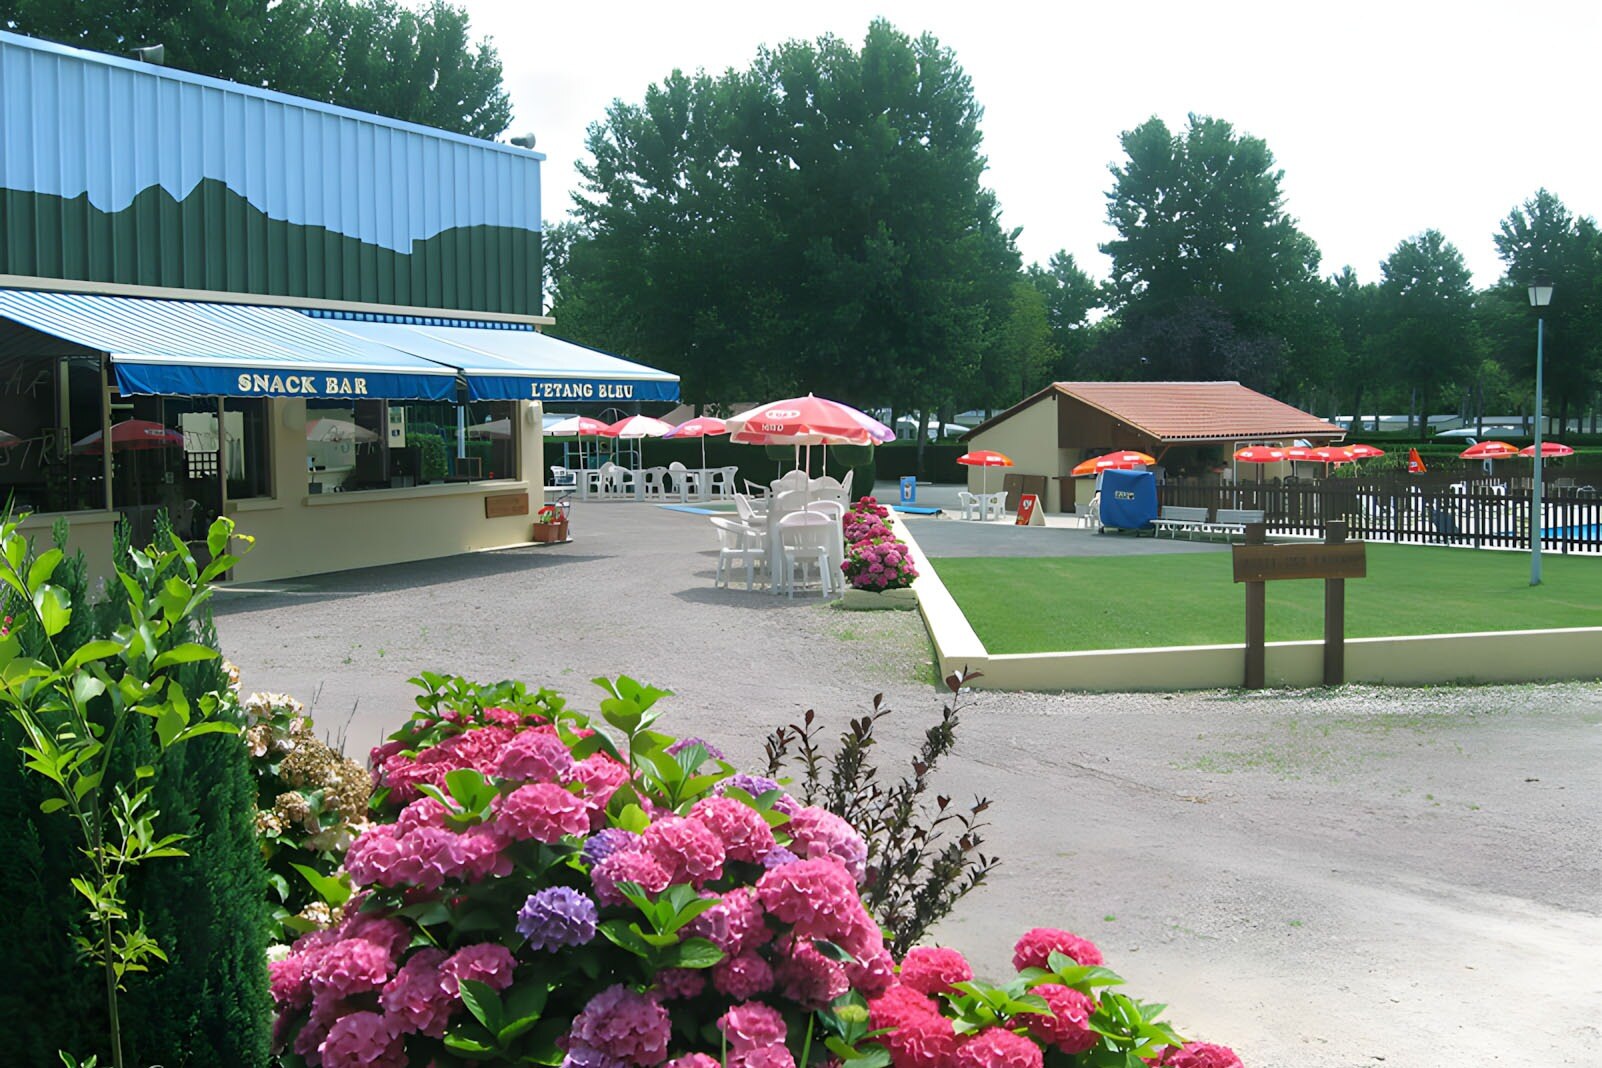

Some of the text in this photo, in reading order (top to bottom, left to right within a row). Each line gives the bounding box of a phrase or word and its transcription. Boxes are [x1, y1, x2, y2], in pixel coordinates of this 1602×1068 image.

[238, 374, 368, 395] SNACK BAR
[531, 383, 593, 398] L'ETANG
